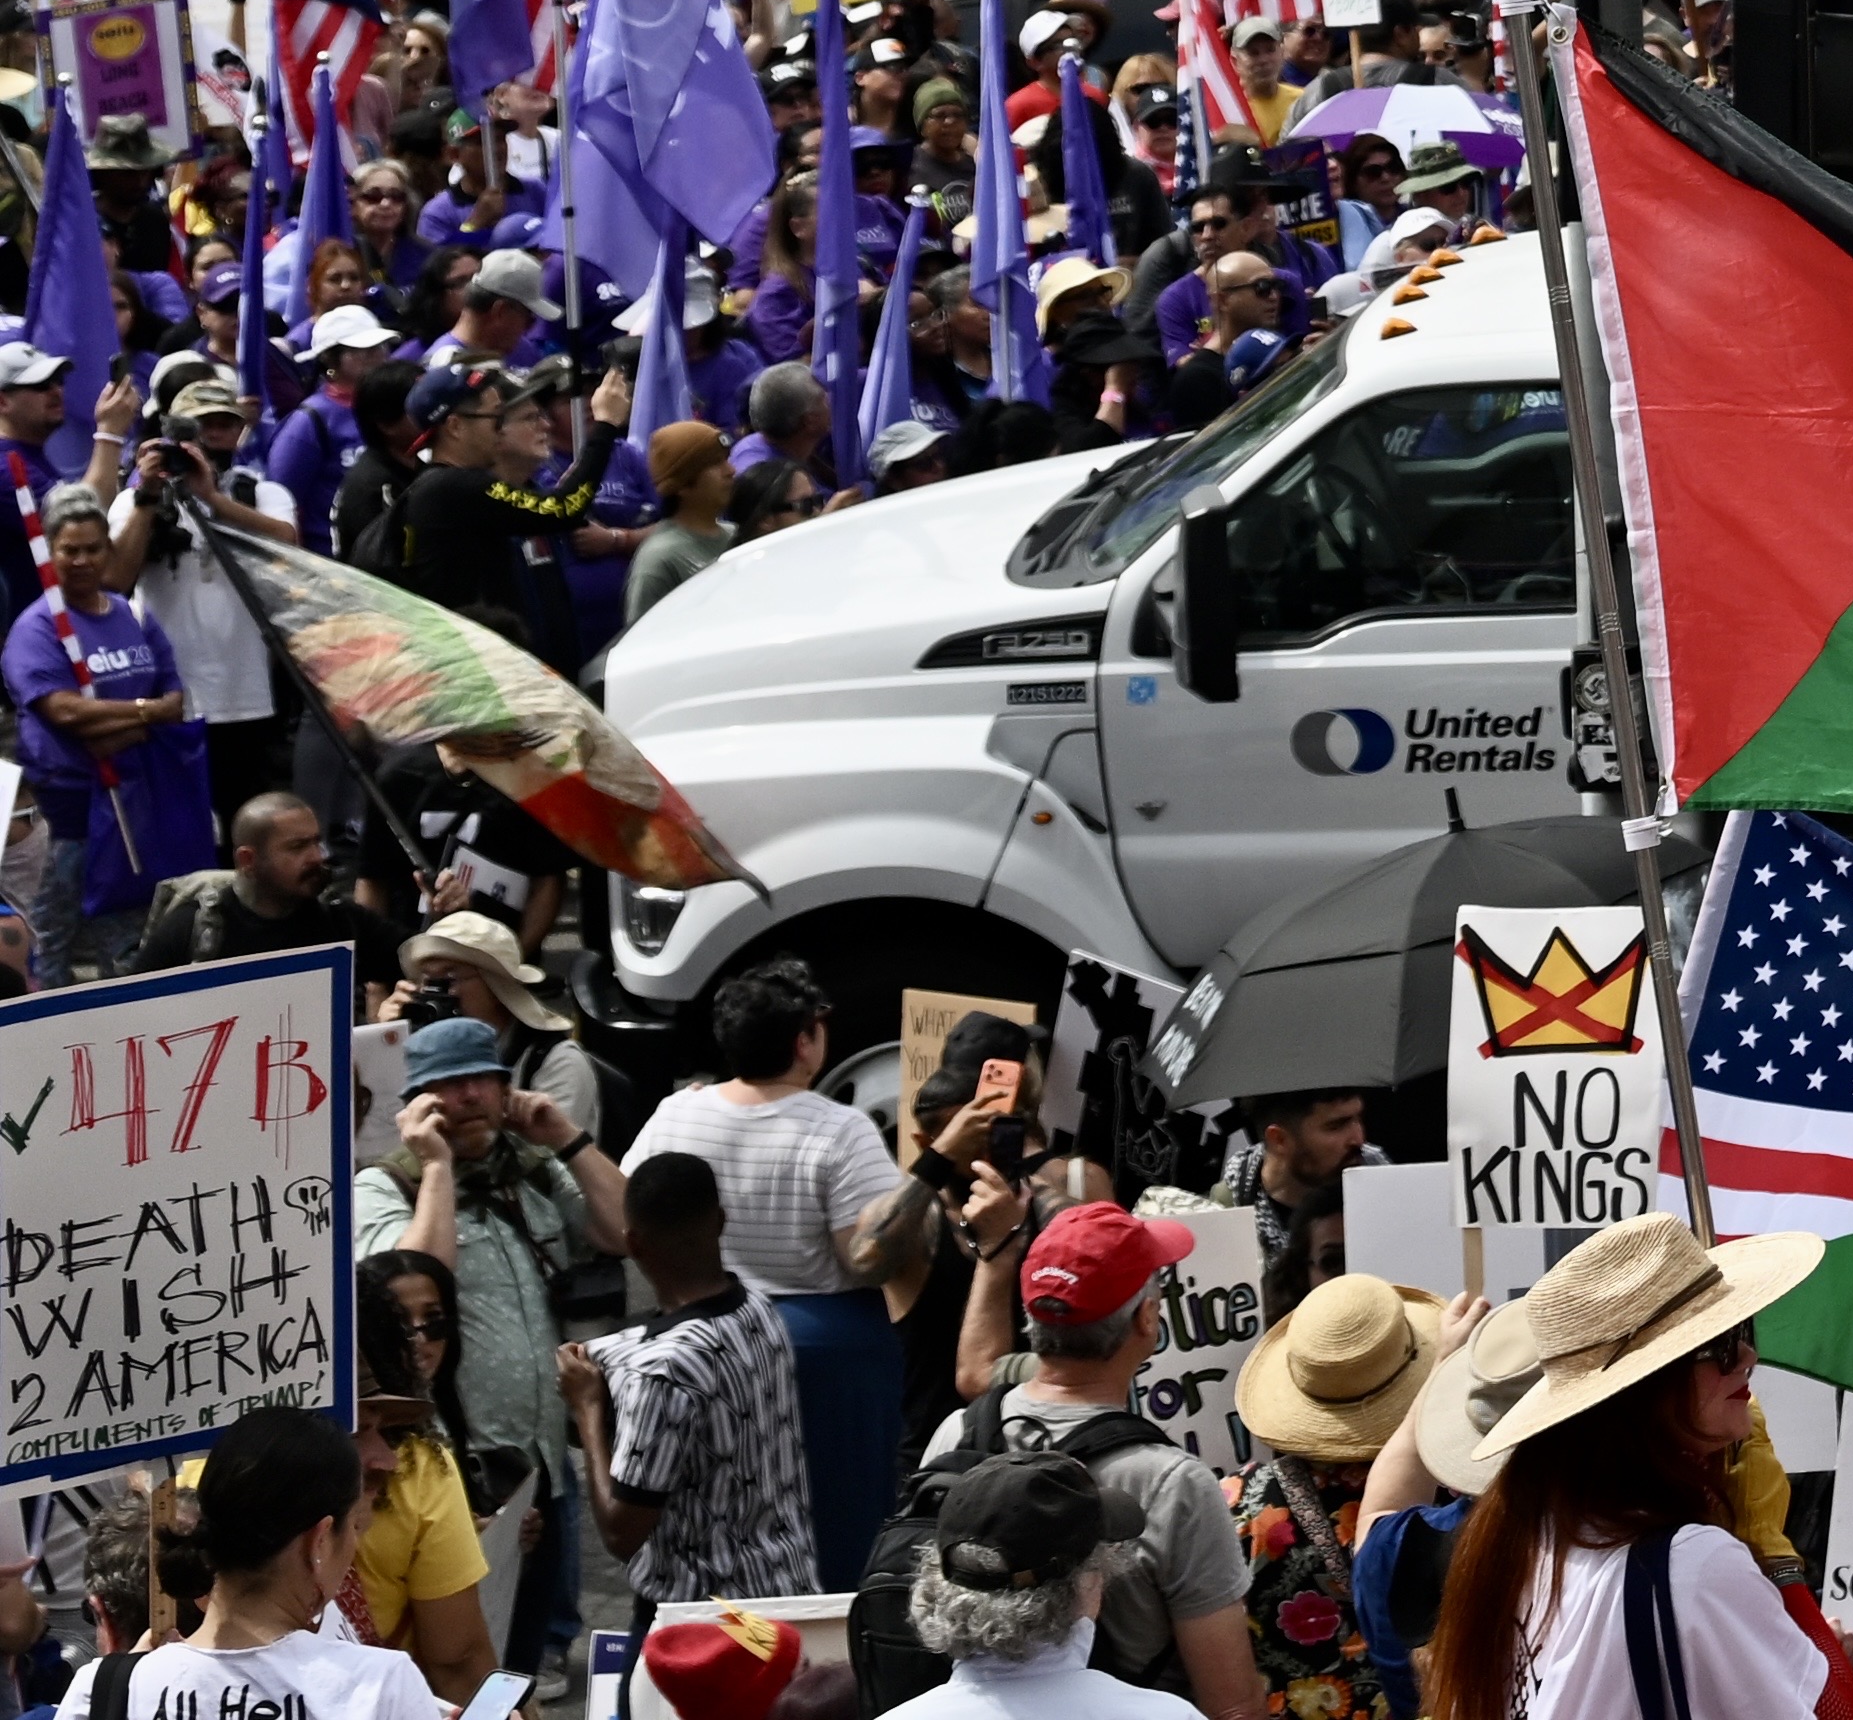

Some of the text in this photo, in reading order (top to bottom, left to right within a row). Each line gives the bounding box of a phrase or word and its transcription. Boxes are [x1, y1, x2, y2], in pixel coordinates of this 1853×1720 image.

[1404, 707, 1542, 740] United
[1404, 738, 1556, 775] Rentals
[1512, 1066, 1622, 1152] NO
[1462, 1146, 1655, 1225] KINGS
[2, 1175, 280, 1288] DEATH
[5, 1247, 311, 1360] WISH
[8, 1296, 328, 1436] 2 AMERICA
